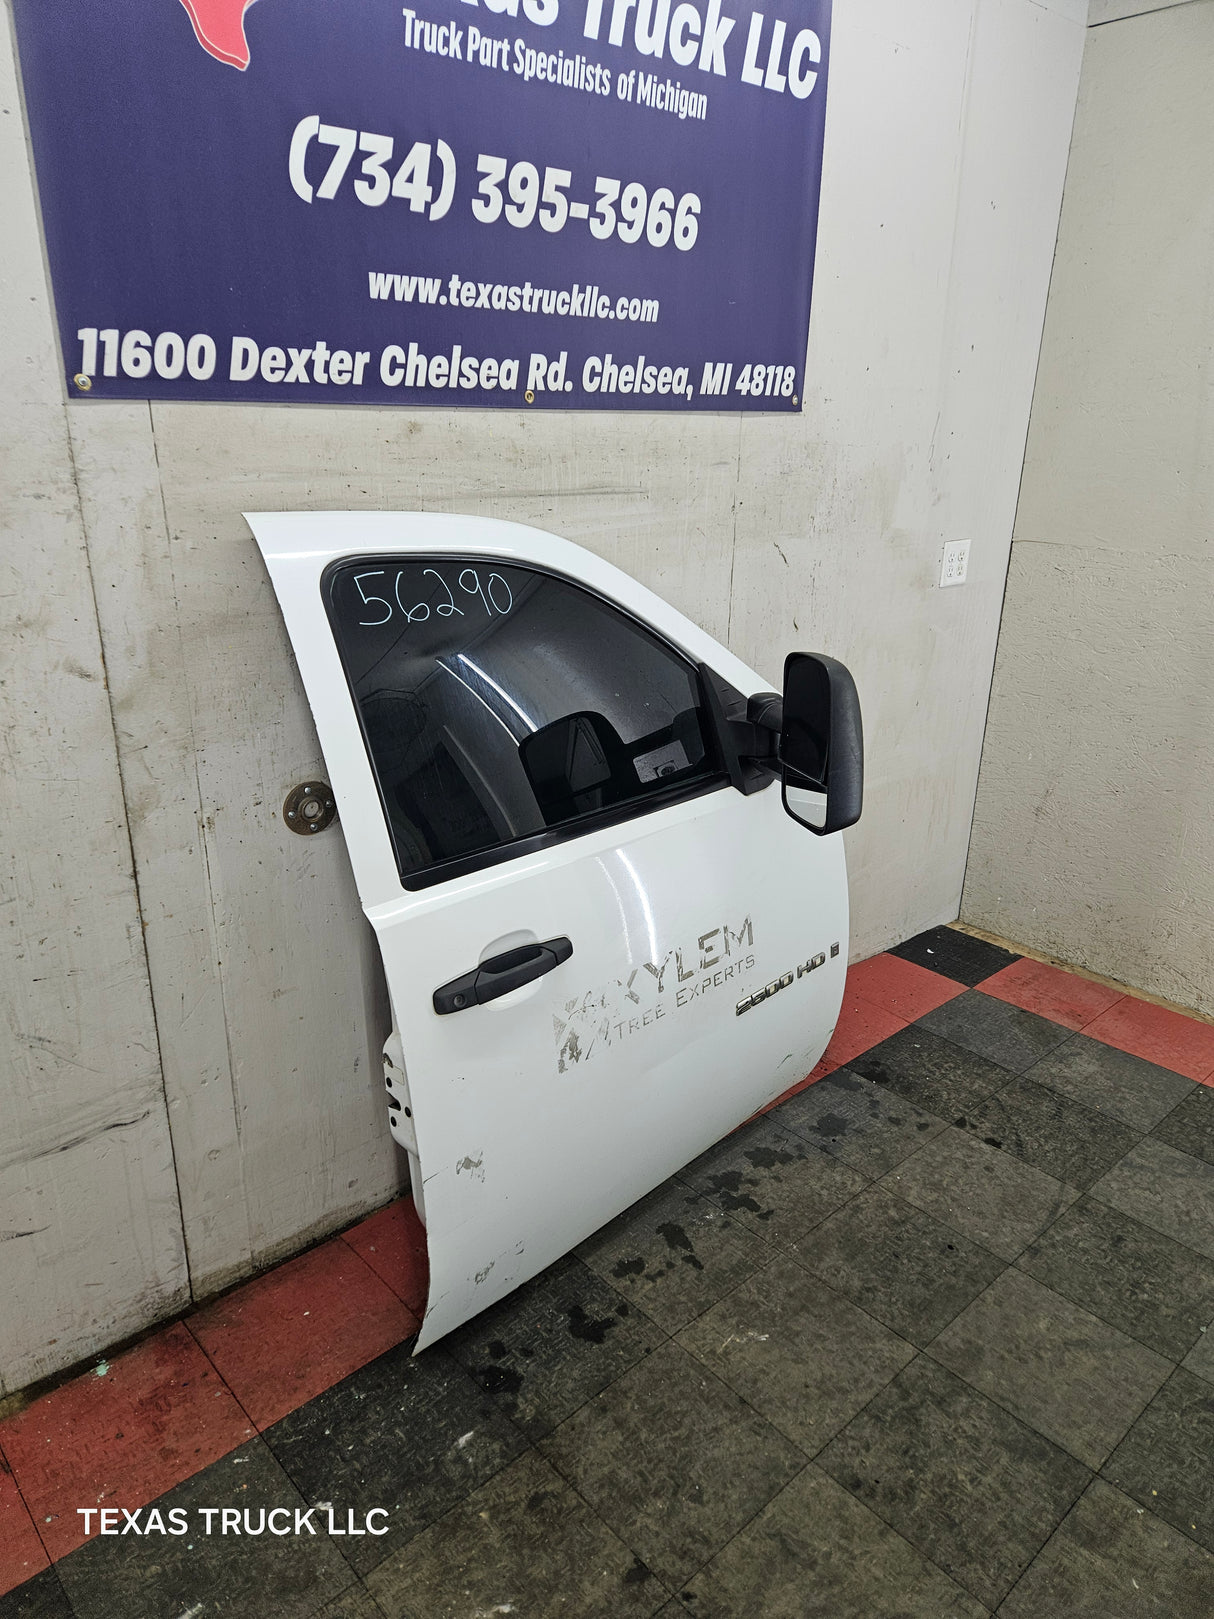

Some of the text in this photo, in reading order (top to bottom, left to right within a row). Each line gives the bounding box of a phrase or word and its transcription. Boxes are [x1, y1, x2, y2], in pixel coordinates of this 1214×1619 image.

[402, 8, 463, 60] Truck
[467, 26, 510, 72] Part
[513, 38, 611, 97] Specialists
[616, 69, 635, 102] of
[637, 71, 708, 120] Michigan
[741, 11, 822, 100] LLC
[288, 115, 701, 251] (734) 395-3966
[368, 271, 660, 323] www.texastruckllc.com
[77, 327, 796, 401] 11600 Dexter Chelsea Rd. Chelsea, MI 48118
[353, 568, 513, 626] 56290
[613, 954, 756, 1040] TREE EXPERTS
[735, 951, 826, 1017] 2500 HD
